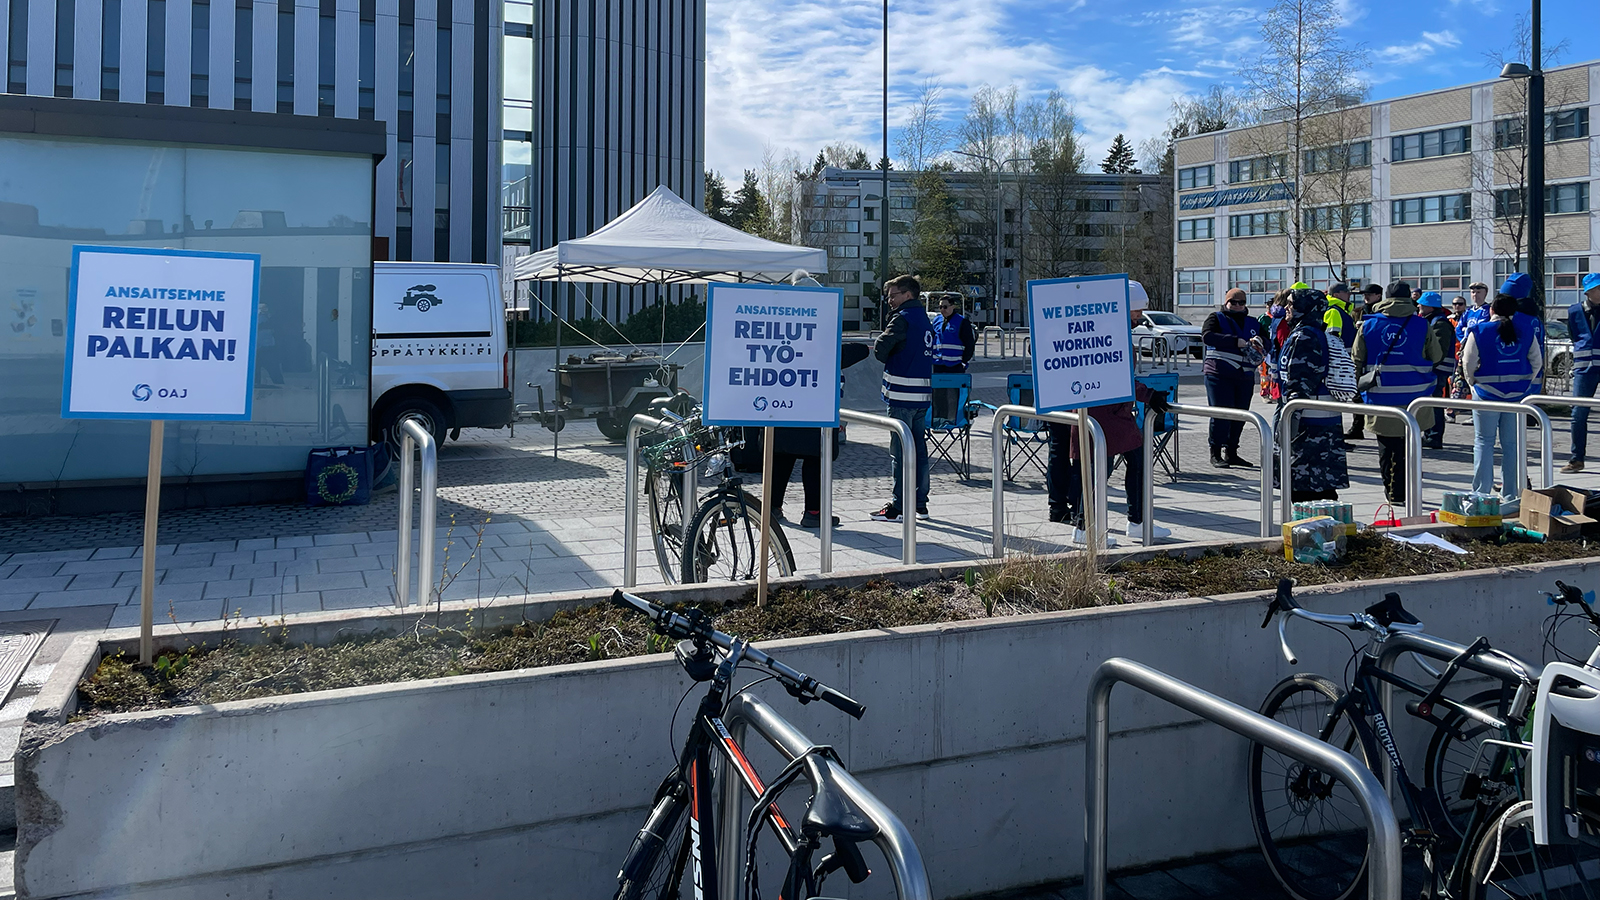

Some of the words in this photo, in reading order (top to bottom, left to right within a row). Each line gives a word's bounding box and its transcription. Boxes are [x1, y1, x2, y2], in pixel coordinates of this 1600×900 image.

[105, 286, 226, 302] ANSAITSEMME
[102, 306, 225, 332] REILUN
[735, 305, 818, 317] ANSAITSEMME
[1042, 306, 1062, 320] WE
[1065, 301, 1118, 317] DESERVE
[734, 320, 817, 341] REILUT
[1067, 320, 1095, 334] FAIR
[86, 334, 237, 361] PALKAN!
[746, 340, 803, 364] TYÖ-
[1053, 335, 1113, 353] WORKING
[1043, 350, 1123, 371] CONDITIONS!
[728, 367, 819, 388] EHDOT!
[1084, 381, 1101, 391] OAJ
[157, 388, 189, 399] OAJ
[771, 400, 794, 409] OAJ
